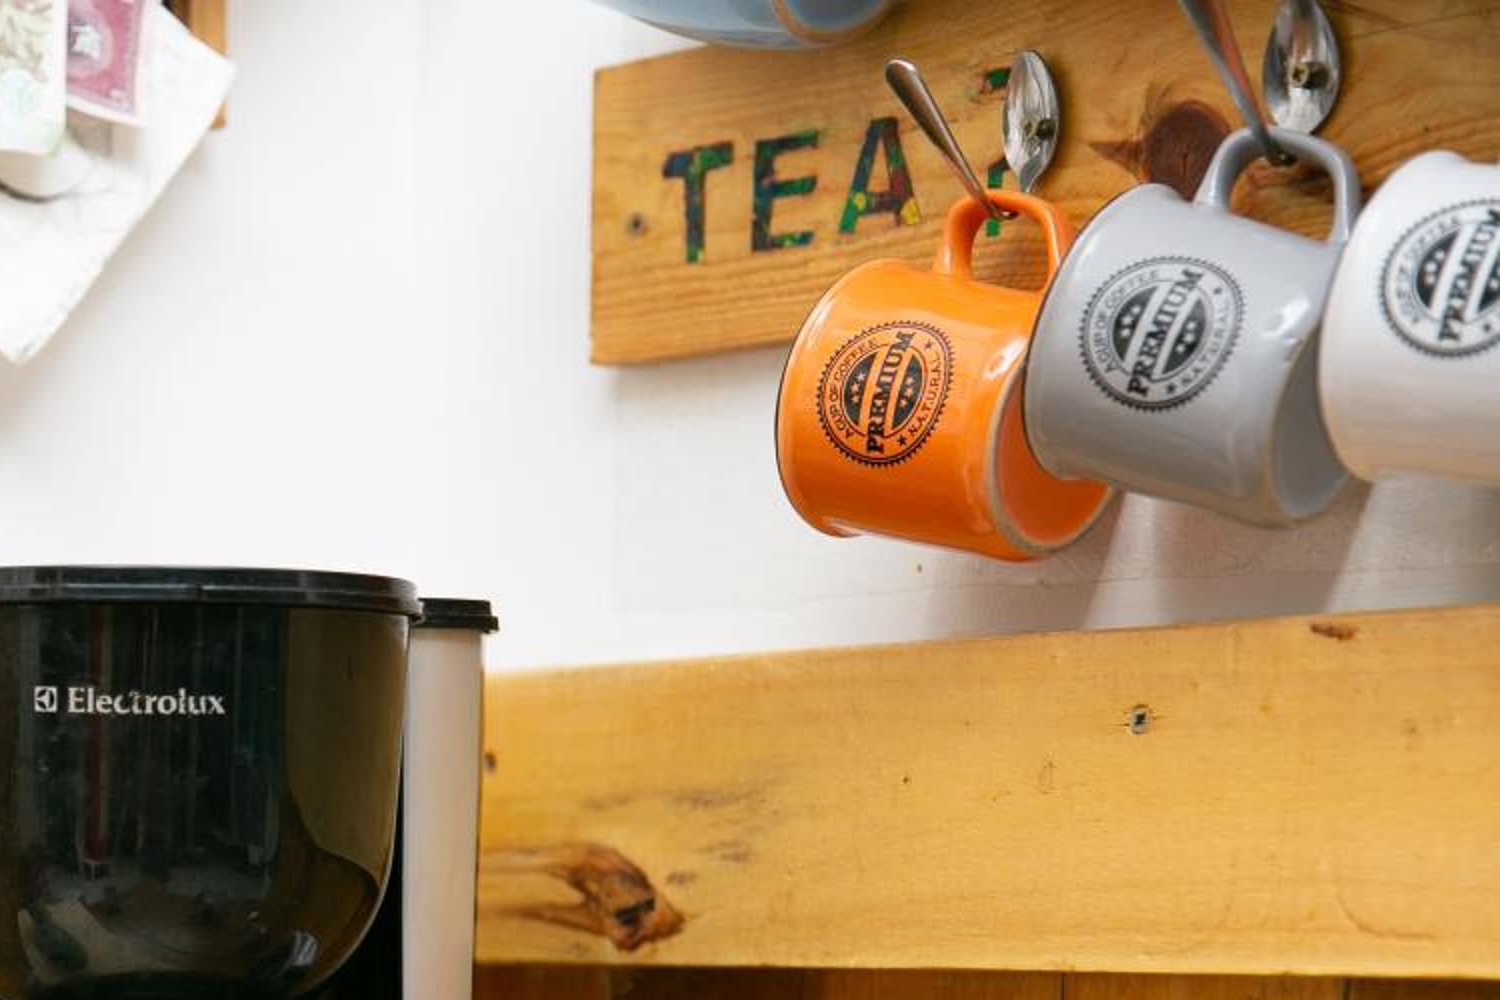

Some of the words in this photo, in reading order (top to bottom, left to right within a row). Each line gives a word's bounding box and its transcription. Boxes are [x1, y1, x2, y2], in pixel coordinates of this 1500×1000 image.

[662, 116, 920, 263] TEA
[866, 331, 916, 453] PREMIUM
[1126, 268, 1204, 397] PREMIUM
[67, 686, 226, 715] Electrolux
